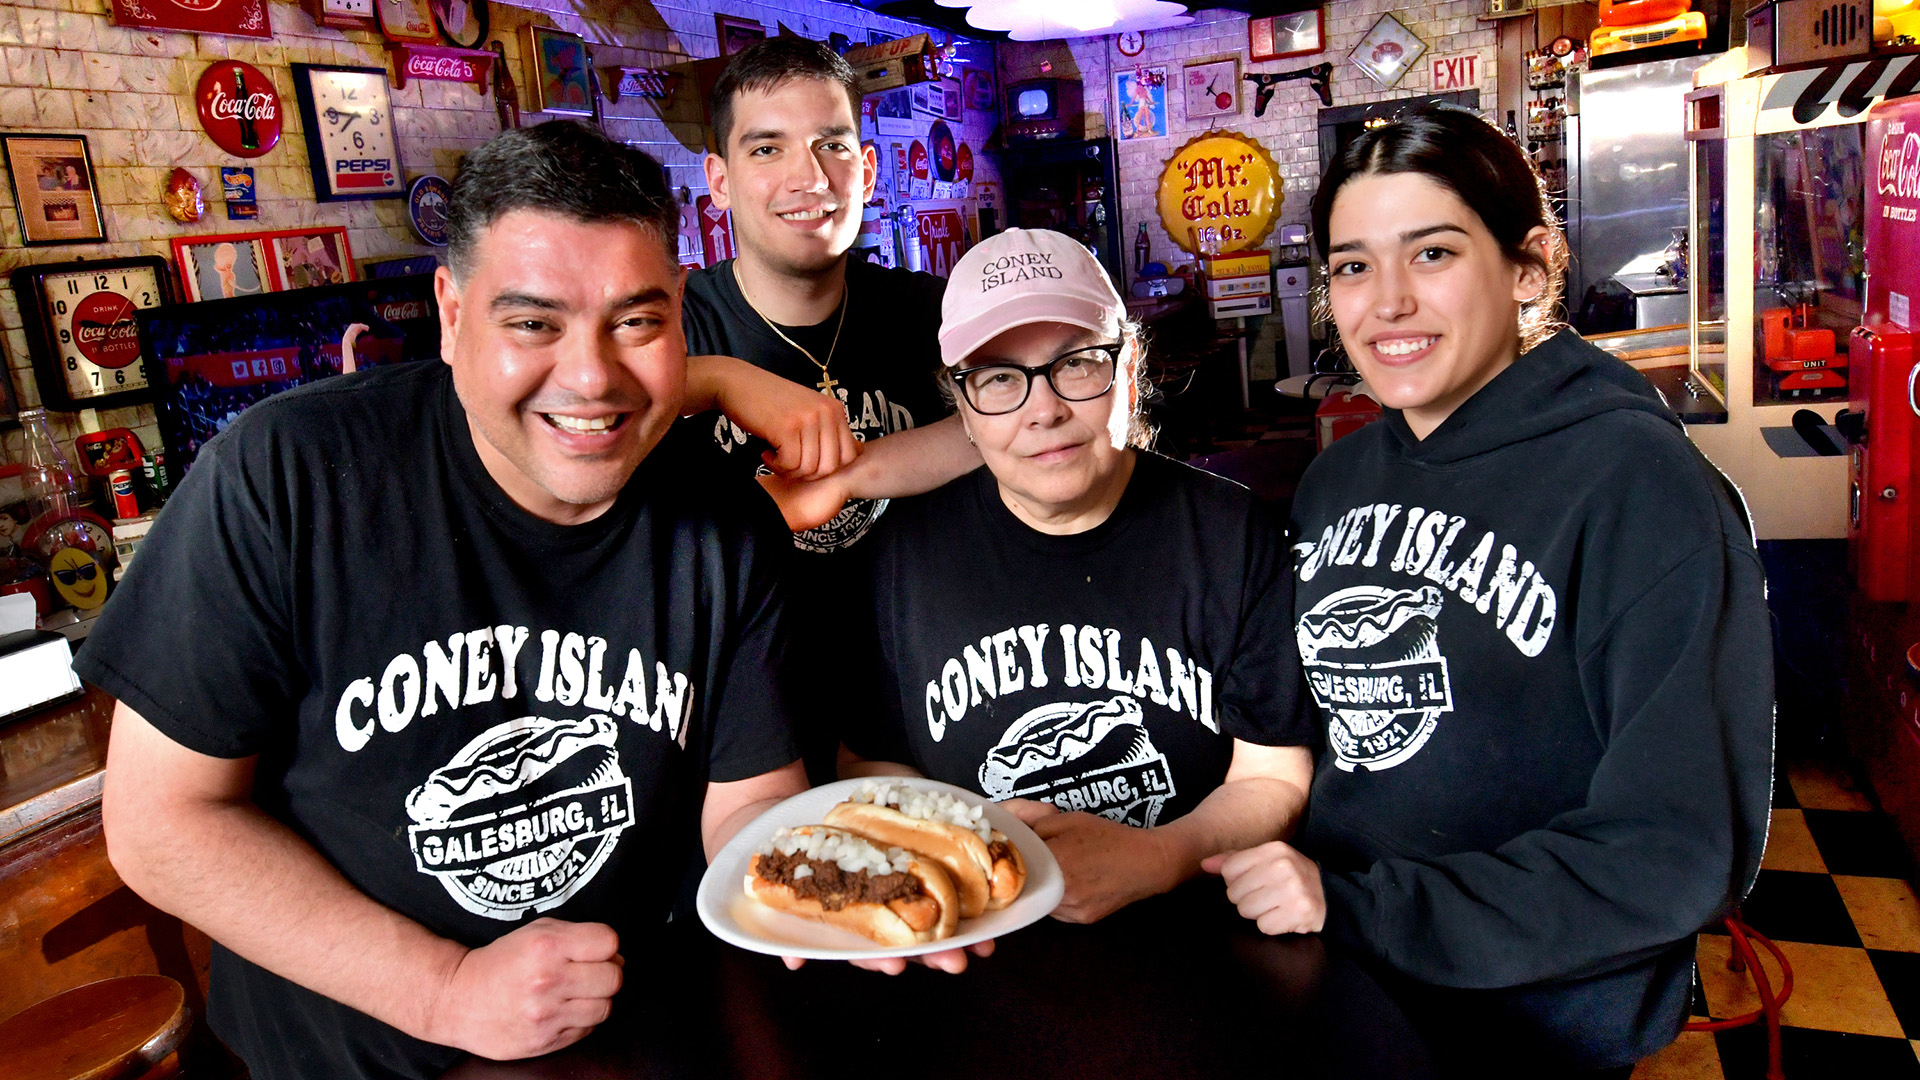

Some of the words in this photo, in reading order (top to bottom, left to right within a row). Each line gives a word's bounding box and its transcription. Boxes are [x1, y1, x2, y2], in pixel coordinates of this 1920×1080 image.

[346, 1, 352, 9] 6
[408, 54, 461, 78] Coca-Cola
[1433, 55, 1478, 90] EXIT
[211, 92, 275, 120] Coca-Cola
[369, 108, 380, 125] 3
[352, 131, 365, 149] 6
[336, 159, 391, 172] PEPSI
[1182, 191, 1250, 221] Cola
[922, 215, 949, 250] Triple
[983, 252, 1052, 275] CONEY
[67, 280, 79, 295] 11
[94, 275, 109, 290] 12
[122, 275, 128, 290] 1
[981, 266, 1063, 293] ISLAND
[51, 300, 67, 315] 10
[142, 292, 152, 306] 2
[93, 305, 118, 313] DRINK
[384, 303, 418, 321] Coca-Cola
[60, 329, 71, 343] 9
[102, 341, 136, 353] BOTTLES
[67, 356, 78, 371] 8
[91, 371, 100, 386] 7
[115, 369, 125, 384] 6
[1390, 506, 1557, 658] ISLAND
[335, 624, 529, 752] CONEY
[536, 629, 694, 751] ISLAN
[925, 622, 1049, 743] CONEY
[1418, 672, 1445, 701] IL
[1362, 722, 1409, 755] 1921
[1040, 775, 1139, 814] SBURG,
[1141, 769, 1167, 793] IL
[422, 801, 594, 866] GALESBURG,
[601, 793, 627, 824] IL
[468, 875, 535, 902] SINCE
[541, 850, 587, 893] 1921
